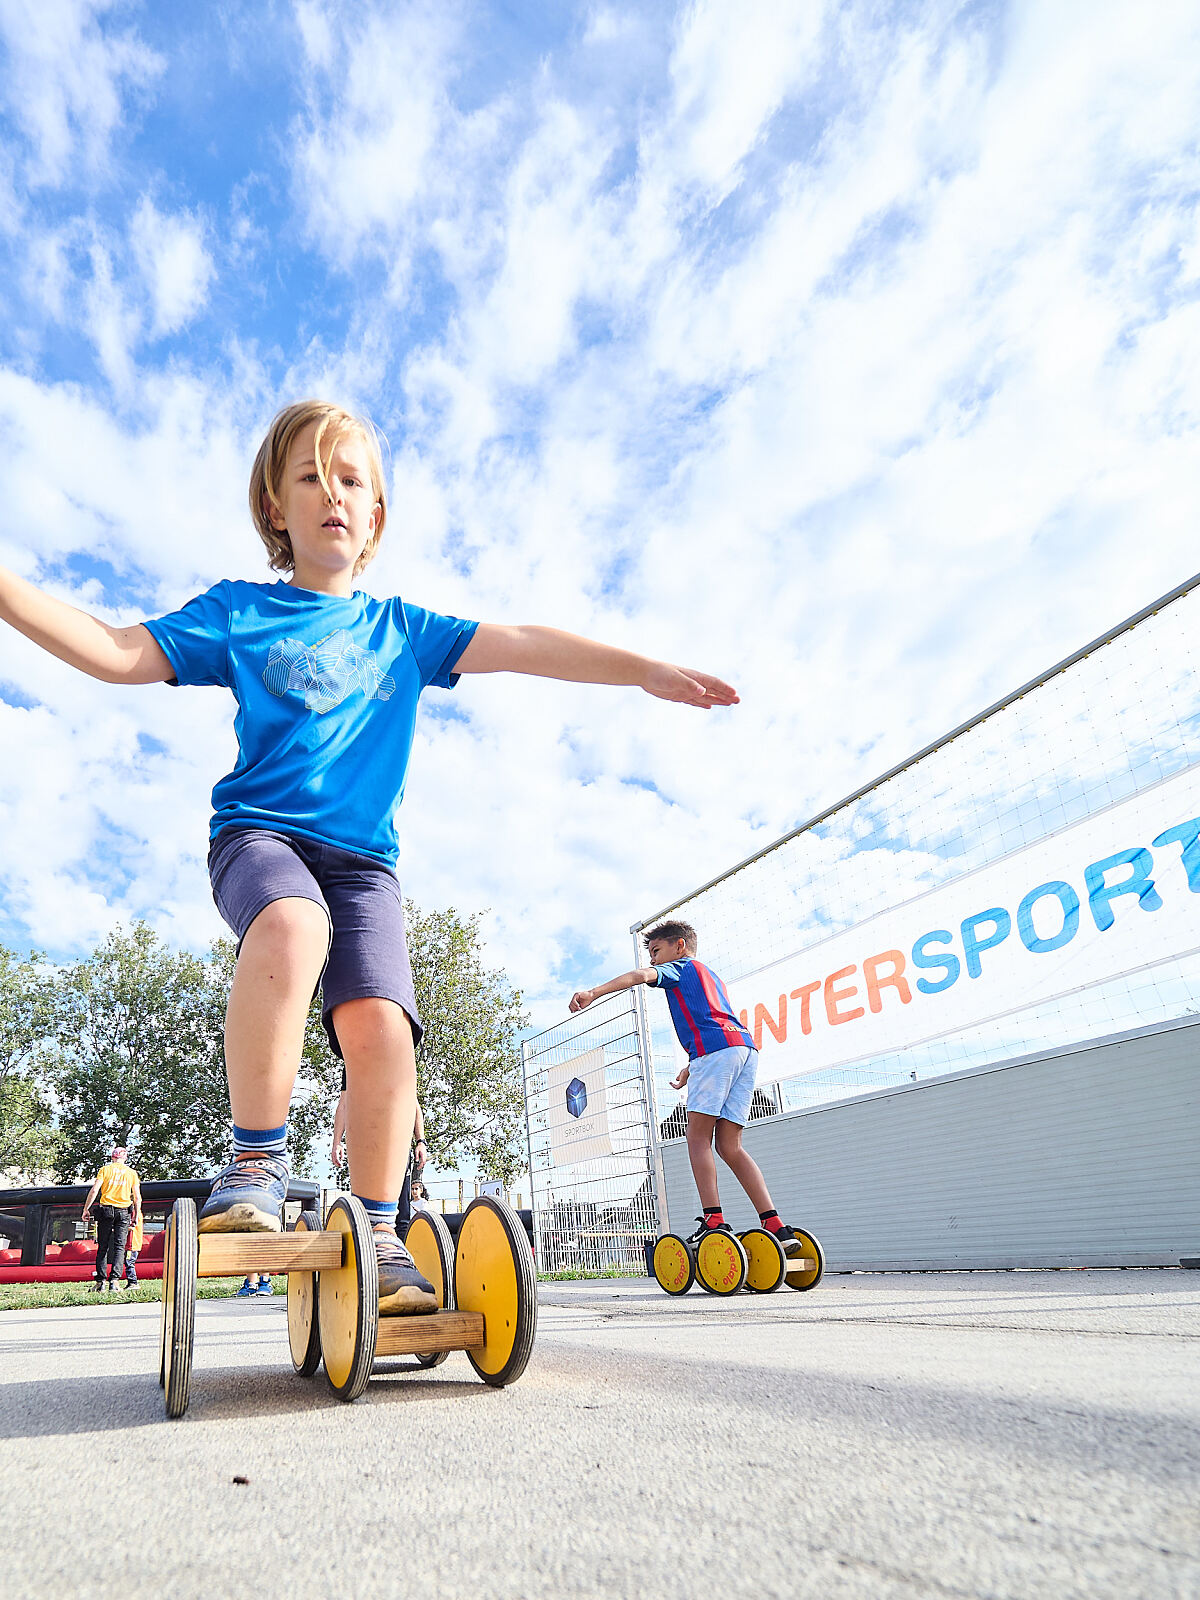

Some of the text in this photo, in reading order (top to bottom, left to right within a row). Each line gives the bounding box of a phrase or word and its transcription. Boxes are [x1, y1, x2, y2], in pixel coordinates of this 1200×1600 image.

[236, 1160, 277, 1169] GEOX
[674, 1249, 687, 1286] pedalo
[722, 1247, 739, 1286] pedalo
